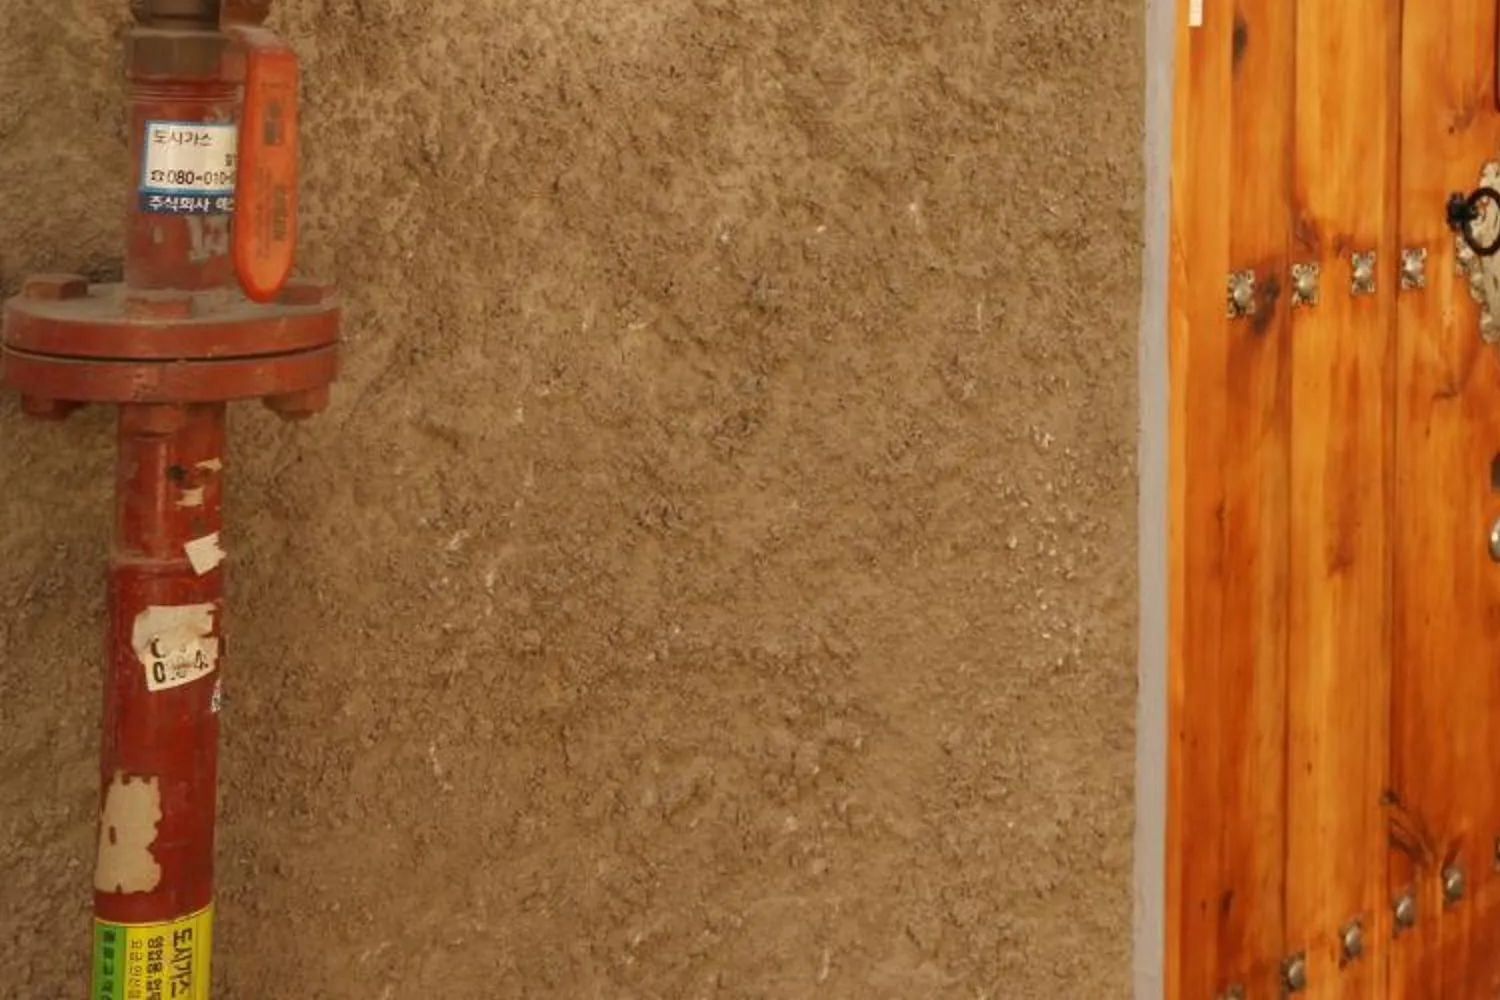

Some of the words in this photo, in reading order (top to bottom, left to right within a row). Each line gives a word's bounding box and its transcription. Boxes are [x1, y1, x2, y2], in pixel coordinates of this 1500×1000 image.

[153, 129, 212, 147] 도시가스
[148, 195, 210, 212] 주식회사
[170, 927, 193, 999] 도시가스
